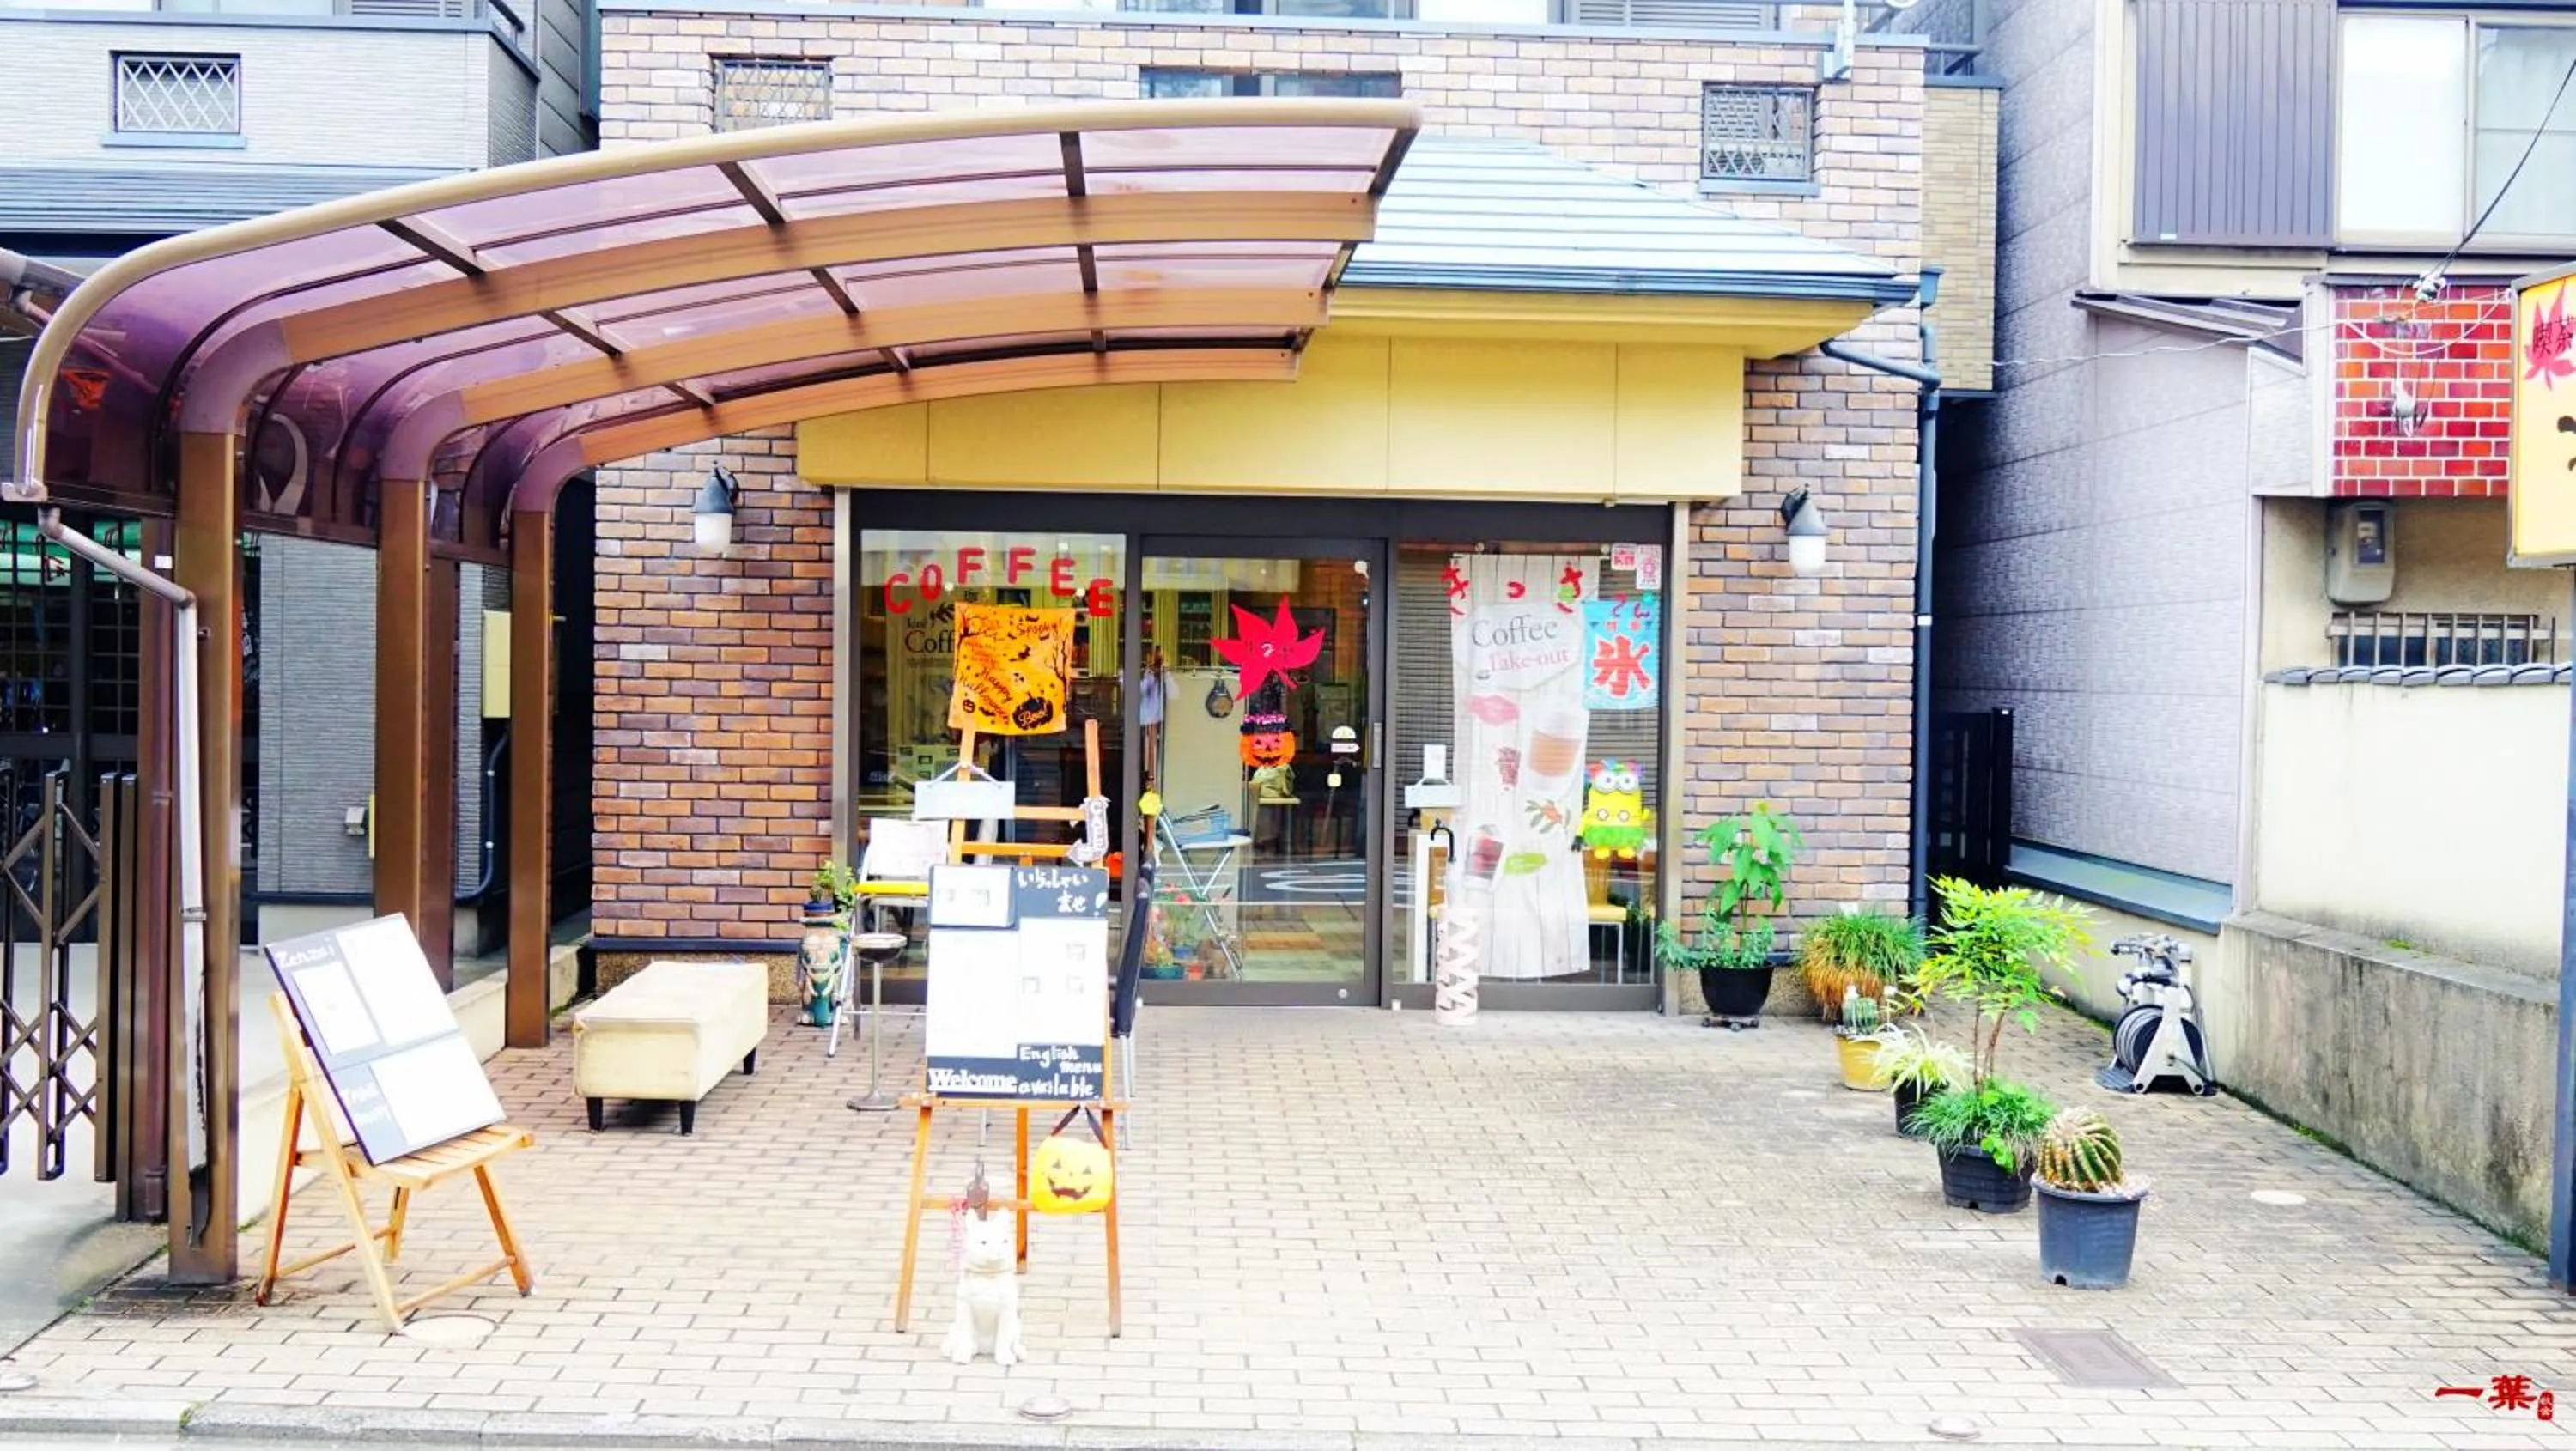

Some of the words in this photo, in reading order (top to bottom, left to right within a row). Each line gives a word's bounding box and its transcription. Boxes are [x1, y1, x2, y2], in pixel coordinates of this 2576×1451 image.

[884, 547, 1115, 618] COFFEE
[905, 628, 955, 653] Coff
[1472, 614, 1558, 647] Coffee
[1593, 634, 1652, 697] 氷
[981, 665, 1012, 704] Happy
[1018, 867, 1089, 889] いらっしゃい
[1019, 1045, 1080, 1068] English
[1059, 1061, 1103, 1074] menu
[928, 1068, 1018, 1092] Welcome
